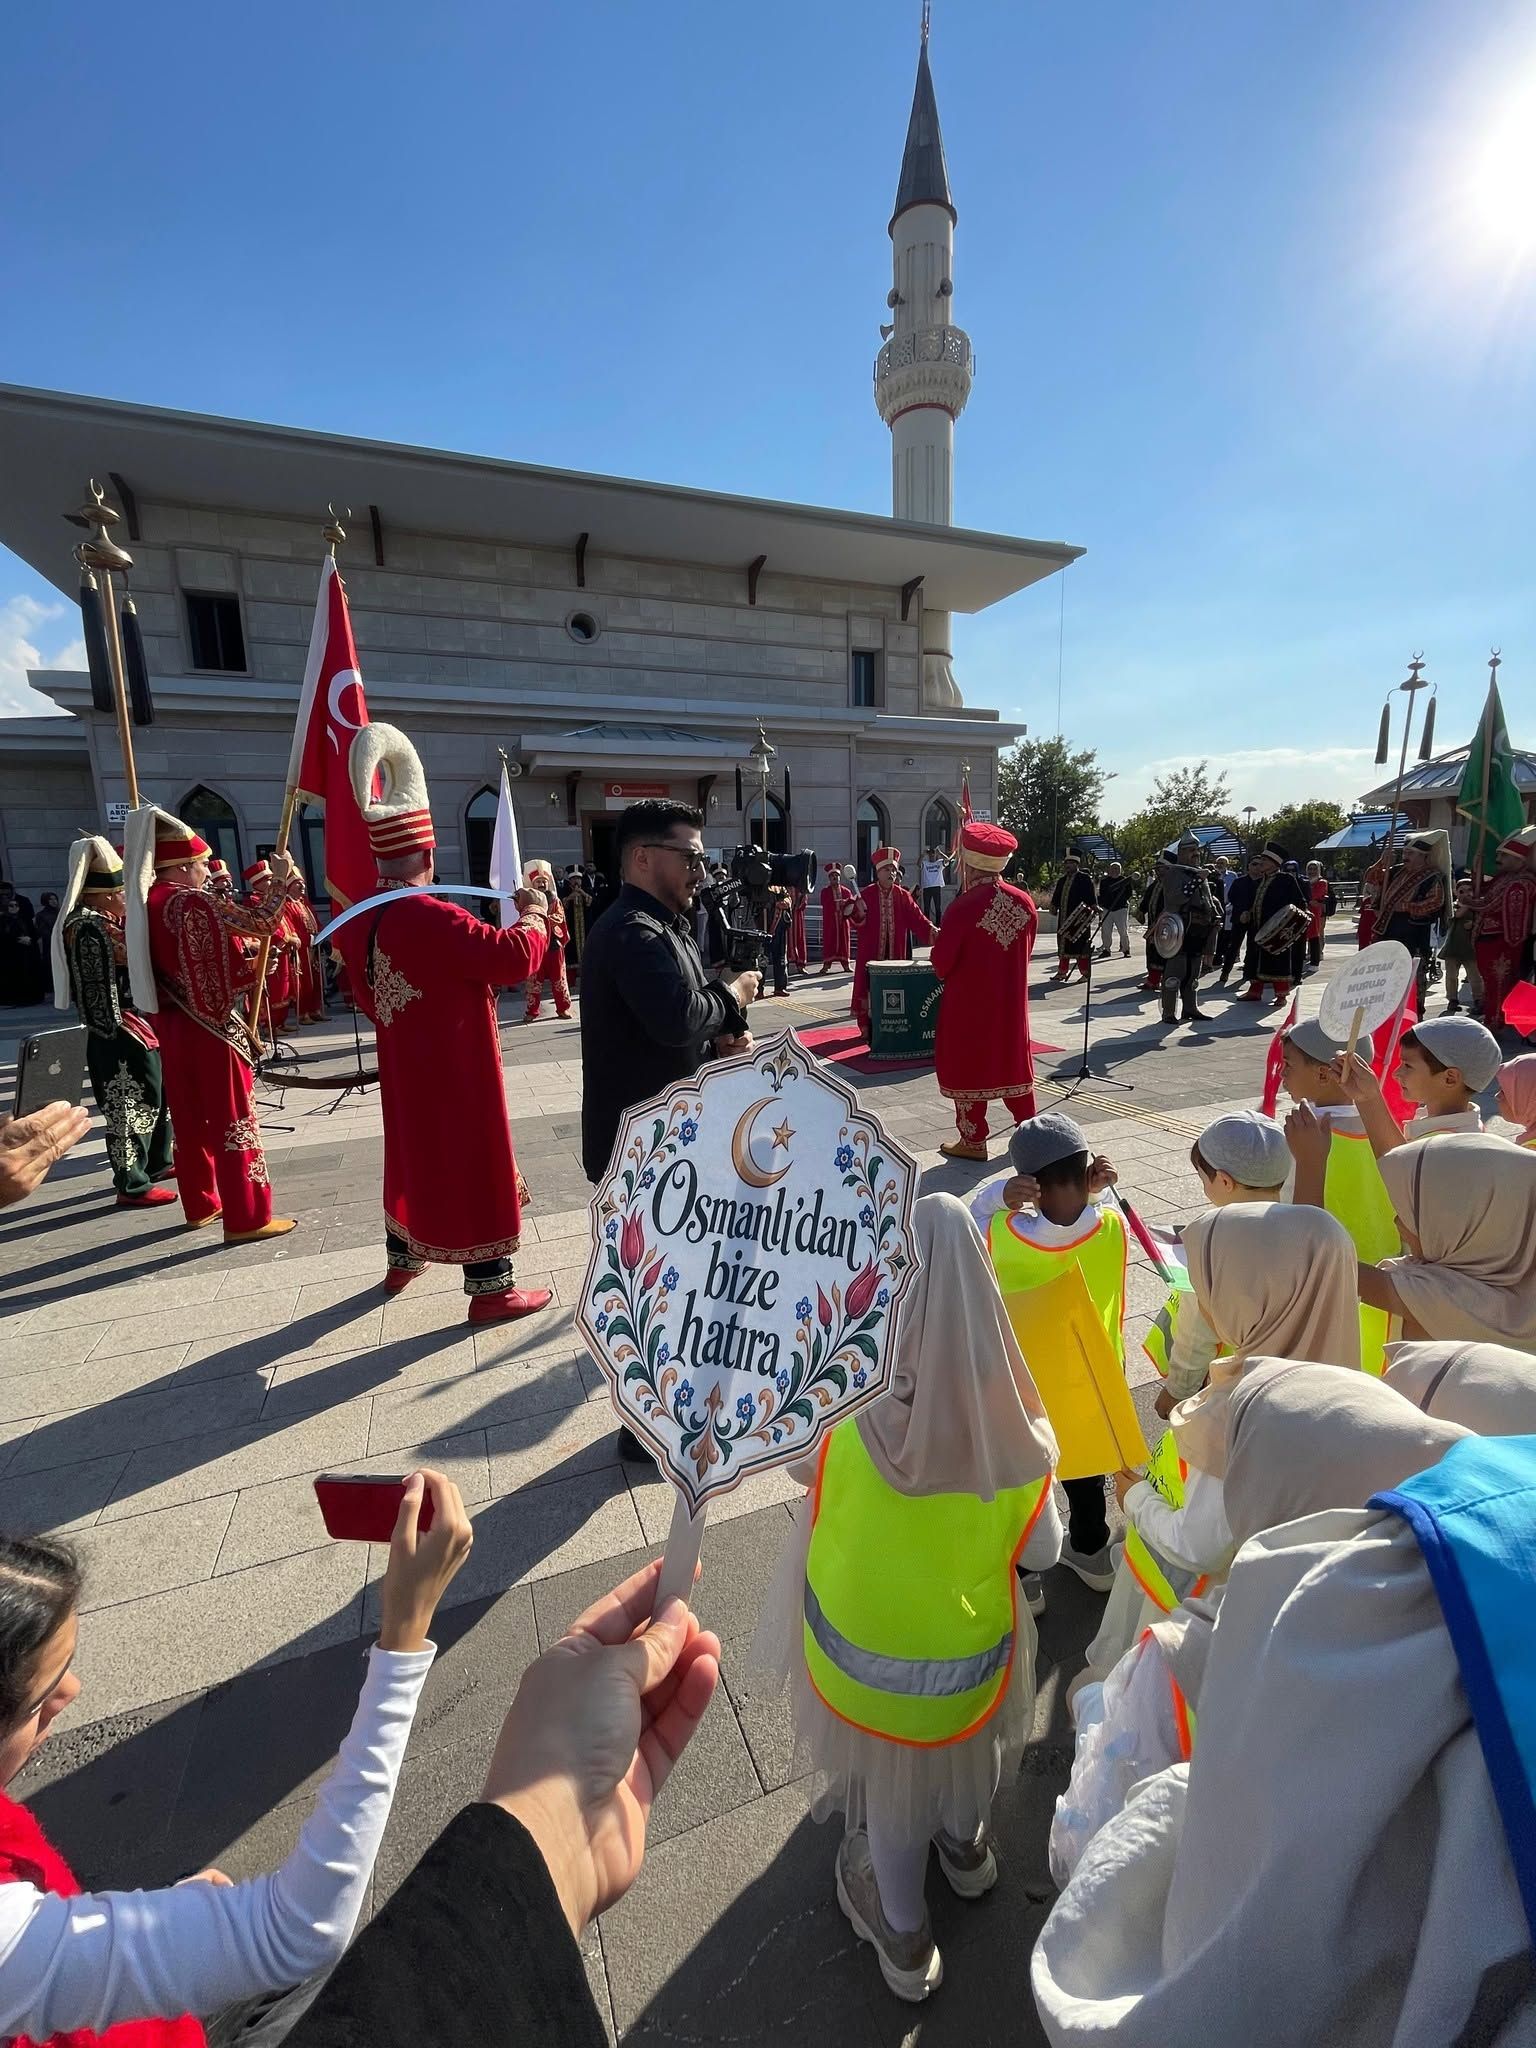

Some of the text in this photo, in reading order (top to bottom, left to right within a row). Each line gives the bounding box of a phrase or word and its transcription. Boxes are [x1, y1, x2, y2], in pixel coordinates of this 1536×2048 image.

[922, 1030, 936, 1040] ME
[651, 1158, 862, 1272] Osmanlı'dan
[703, 1240, 780, 1311] bize
[669, 1288, 781, 1379] hatıra
